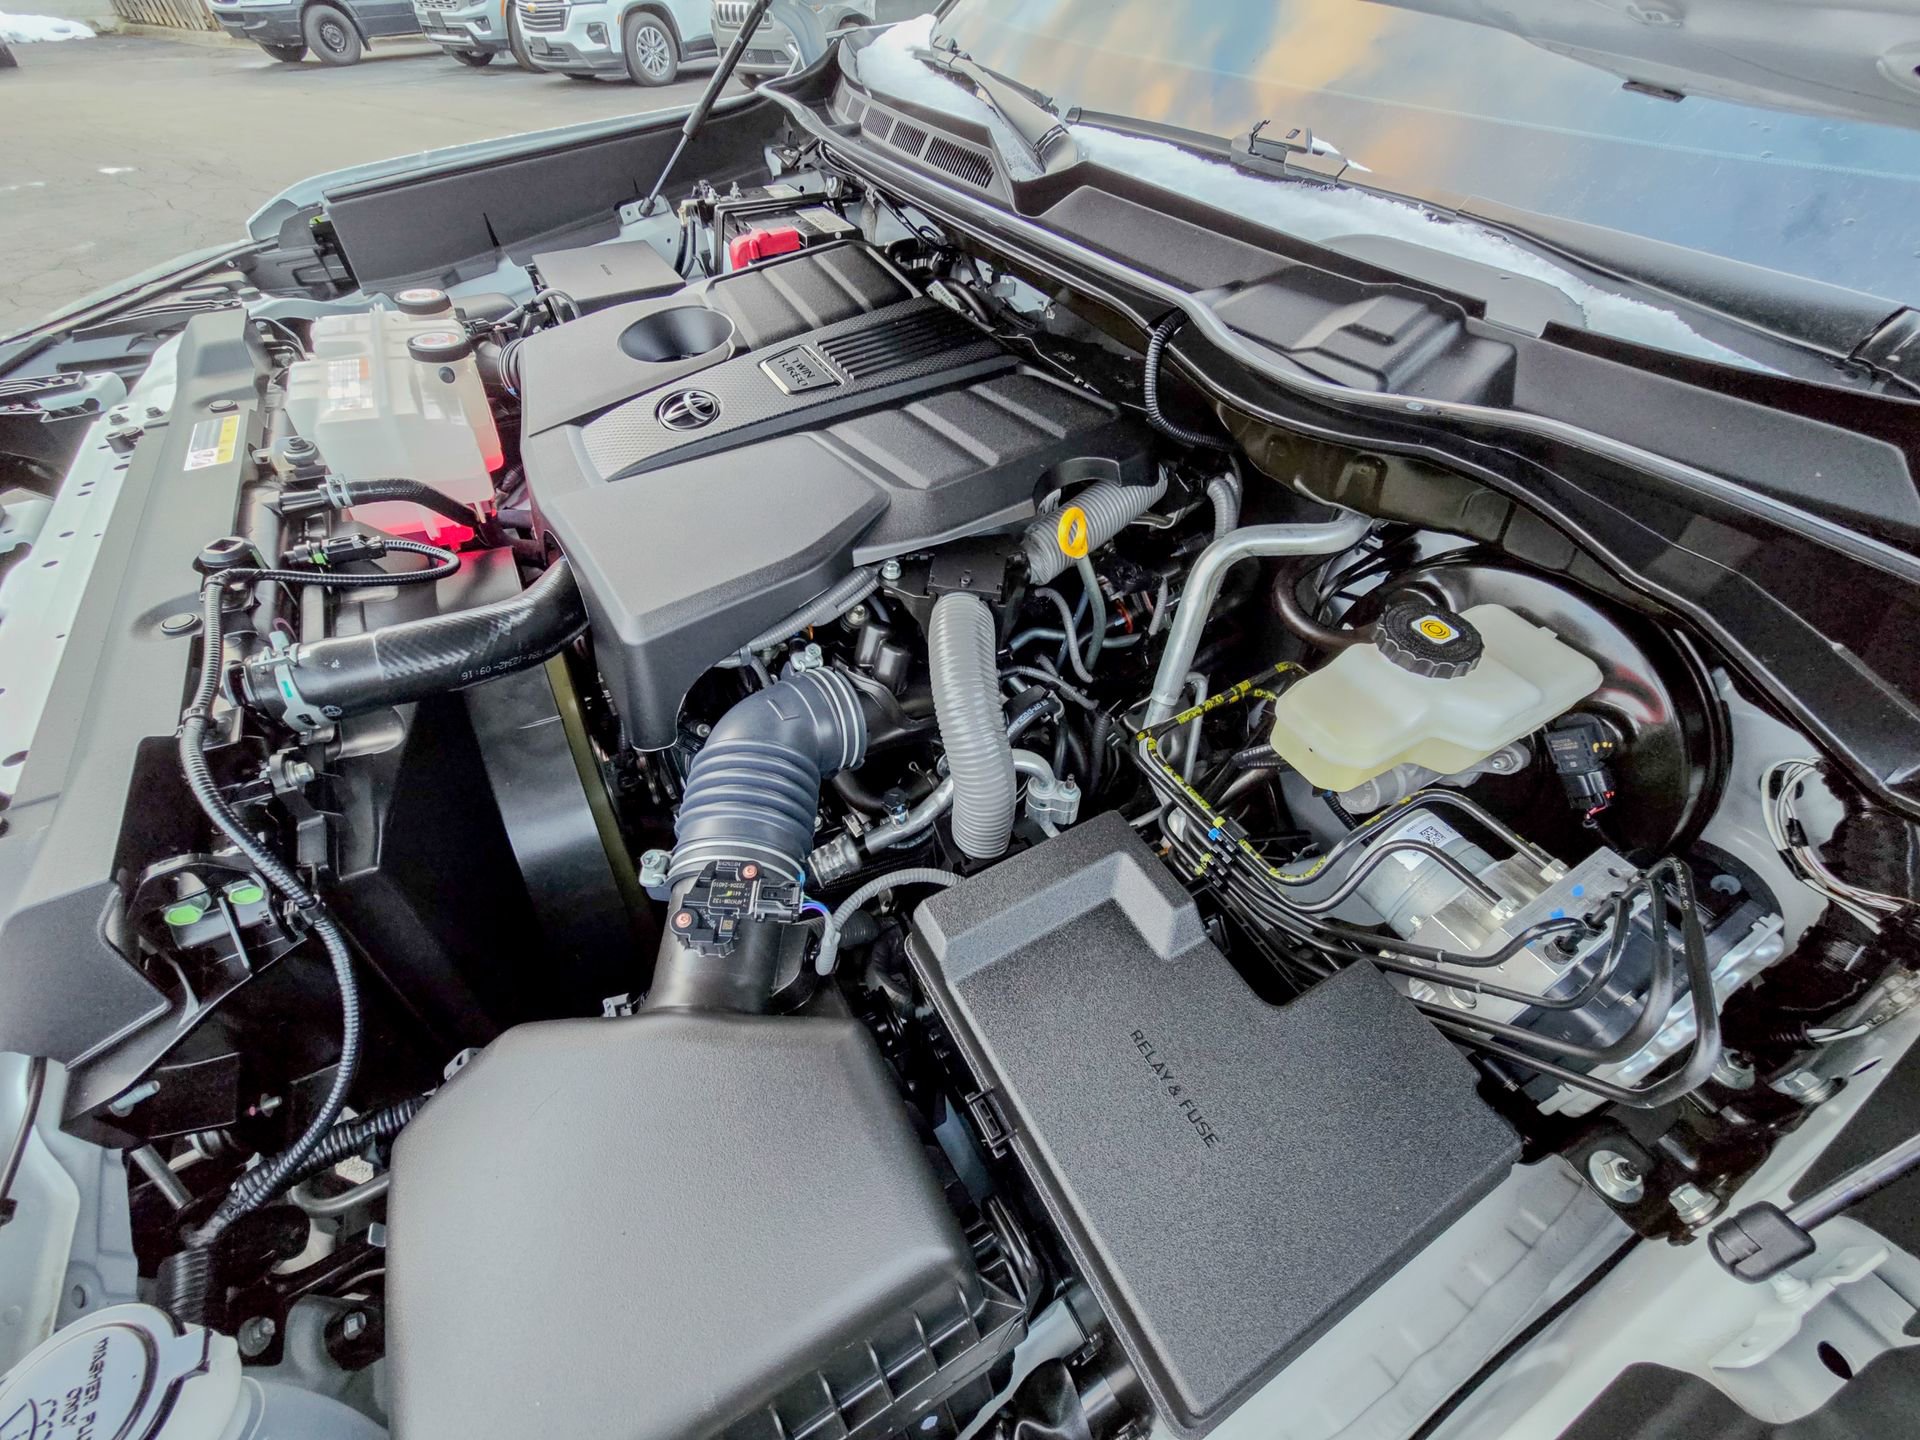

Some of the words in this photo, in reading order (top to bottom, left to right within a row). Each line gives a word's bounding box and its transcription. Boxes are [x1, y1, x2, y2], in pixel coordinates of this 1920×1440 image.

[778, 357, 808, 386] TURBO
[792, 357, 815, 378] TWIN
[1130, 1029, 1174, 1081] RELAY
[1168, 1085, 1181, 1098] &
[1179, 1099, 1221, 1149] FUSE
[83, 1337, 109, 1407] WASHER
[61, 1386, 83, 1428] ONLY
